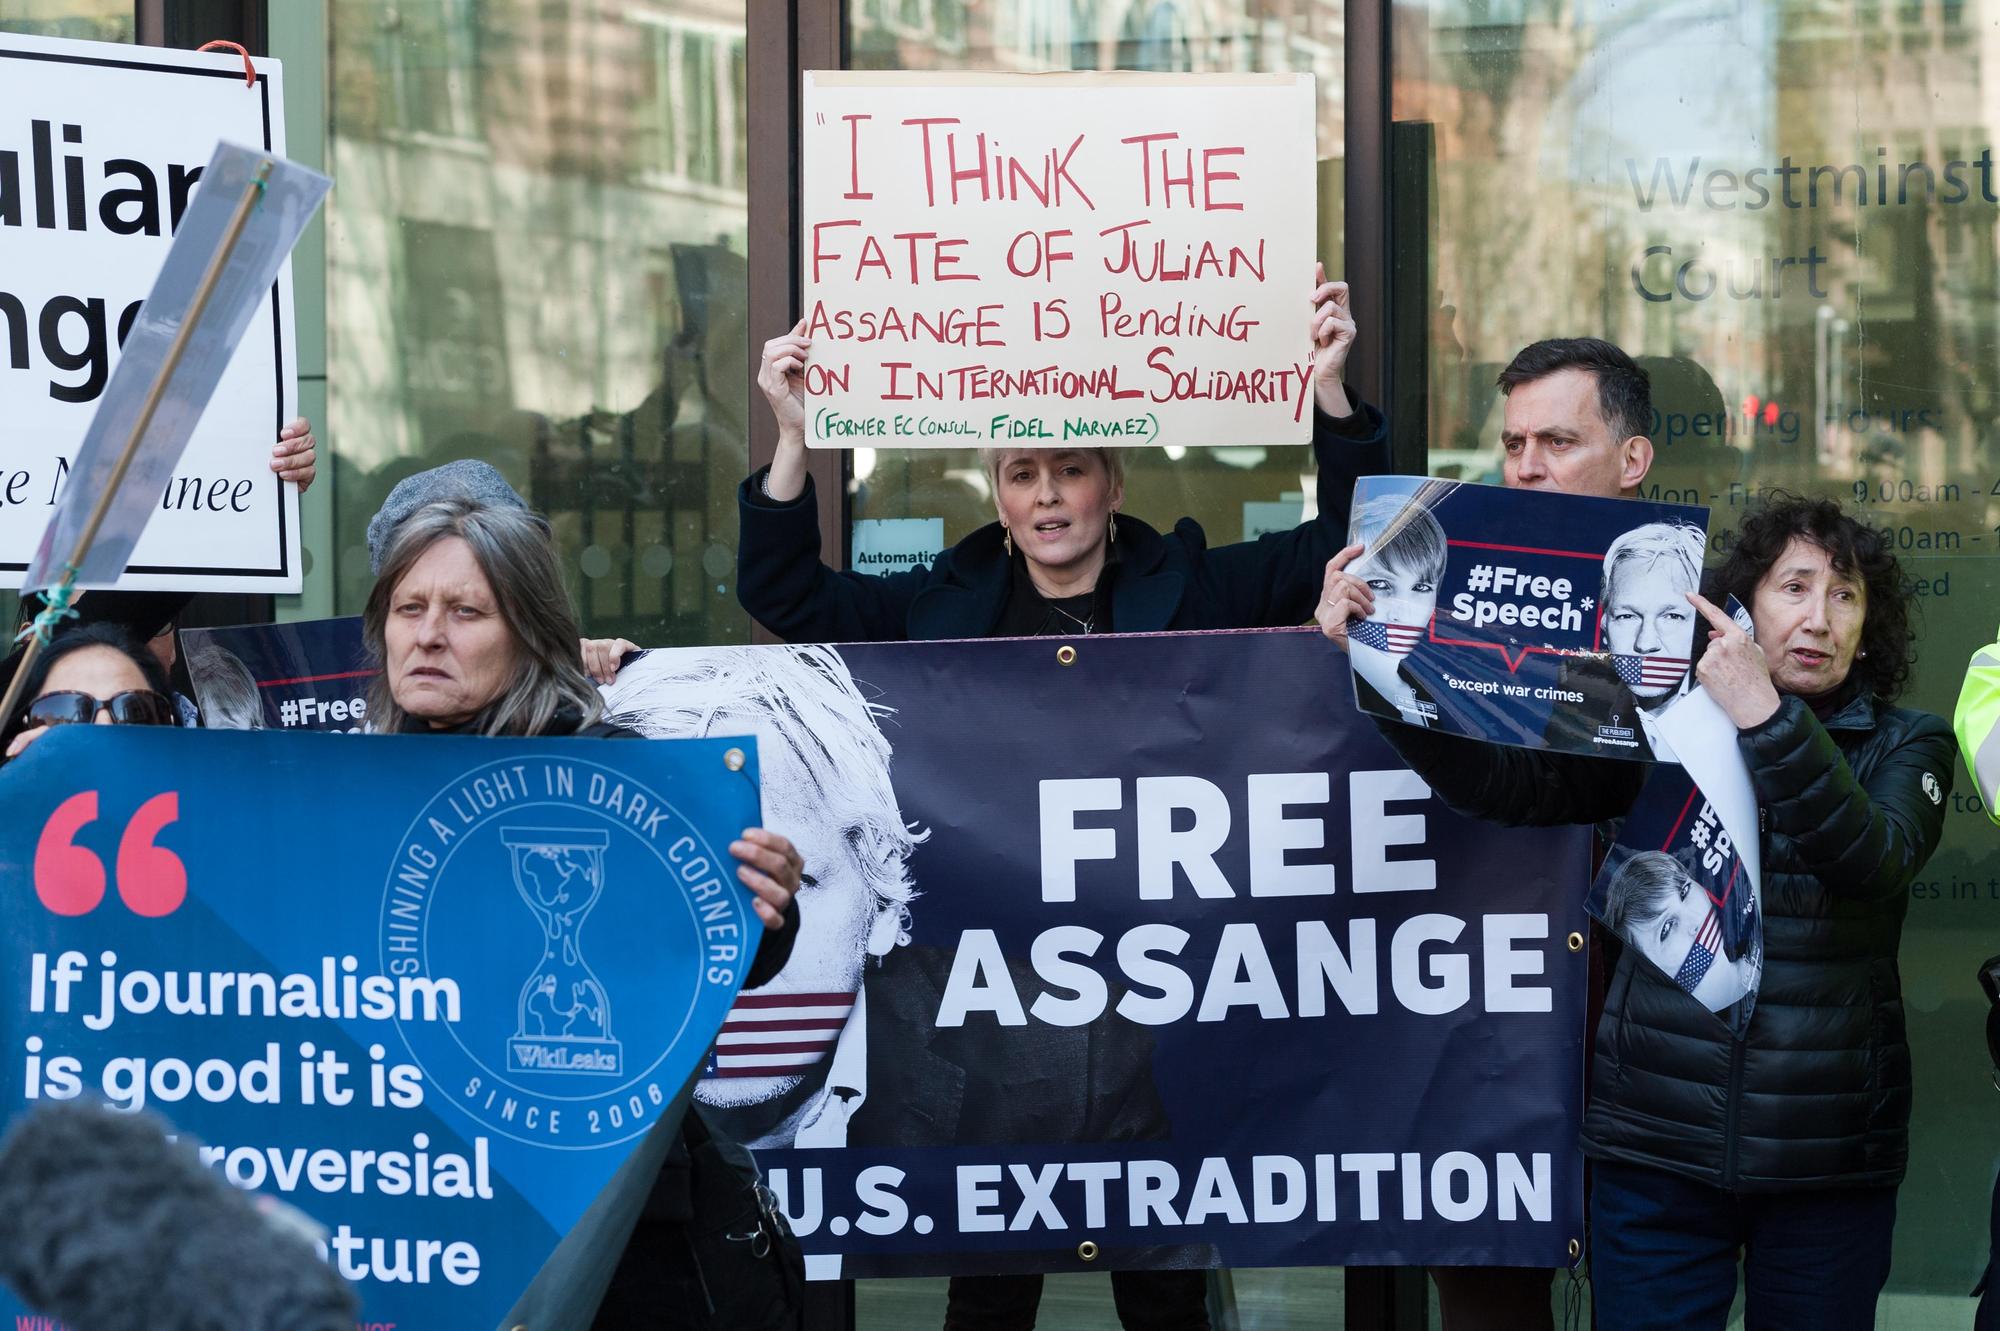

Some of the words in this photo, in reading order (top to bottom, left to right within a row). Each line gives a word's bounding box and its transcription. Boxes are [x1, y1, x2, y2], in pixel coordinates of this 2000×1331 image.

[1121, 131, 1245, 211] THE
[812, 220, 980, 285] FATE
[1006, 229, 1074, 282] OF
[1631, 245, 1828, 302] Court
[808, 299, 1007, 347] ASSANGE
[1033, 298, 1071, 342] IS
[805, 362, 850, 397] ON
[1853, 480, 1960, 504] 9.00am
[1466, 564, 1573, 600] #Free
[280, 698, 368, 727] #Free
[1503, 683, 1531, 698] war
[1534, 686, 1585, 703] crimes
[1039, 769, 1437, 903] FREE
[389, 843, 437, 976] SHINING
[428, 816, 456, 845] A
[448, 765, 530, 825] LIGHT
[545, 765, 574, 799] IN
[588, 773, 671, 839] DARK
[668, 836, 740, 988] CORNERS
[30, 951, 88, 1013] If
[82, 951, 461, 1031] journalism
[935, 912, 1554, 1030] ASSANGE
[25, 1036, 83, 1100] is
[102, 1042, 281, 1114] good
[300, 1041, 354, 1106] it
[369, 1043, 424, 1108] is
[513, 1043, 617, 1072] WikiLeaks
[465, 1077, 561, 1134] SINCE
[588, 1082, 663, 1134] 2006
[768, 1165, 935, 1238] U.S.
[956, 1151, 1552, 1233] EXTRADITION
